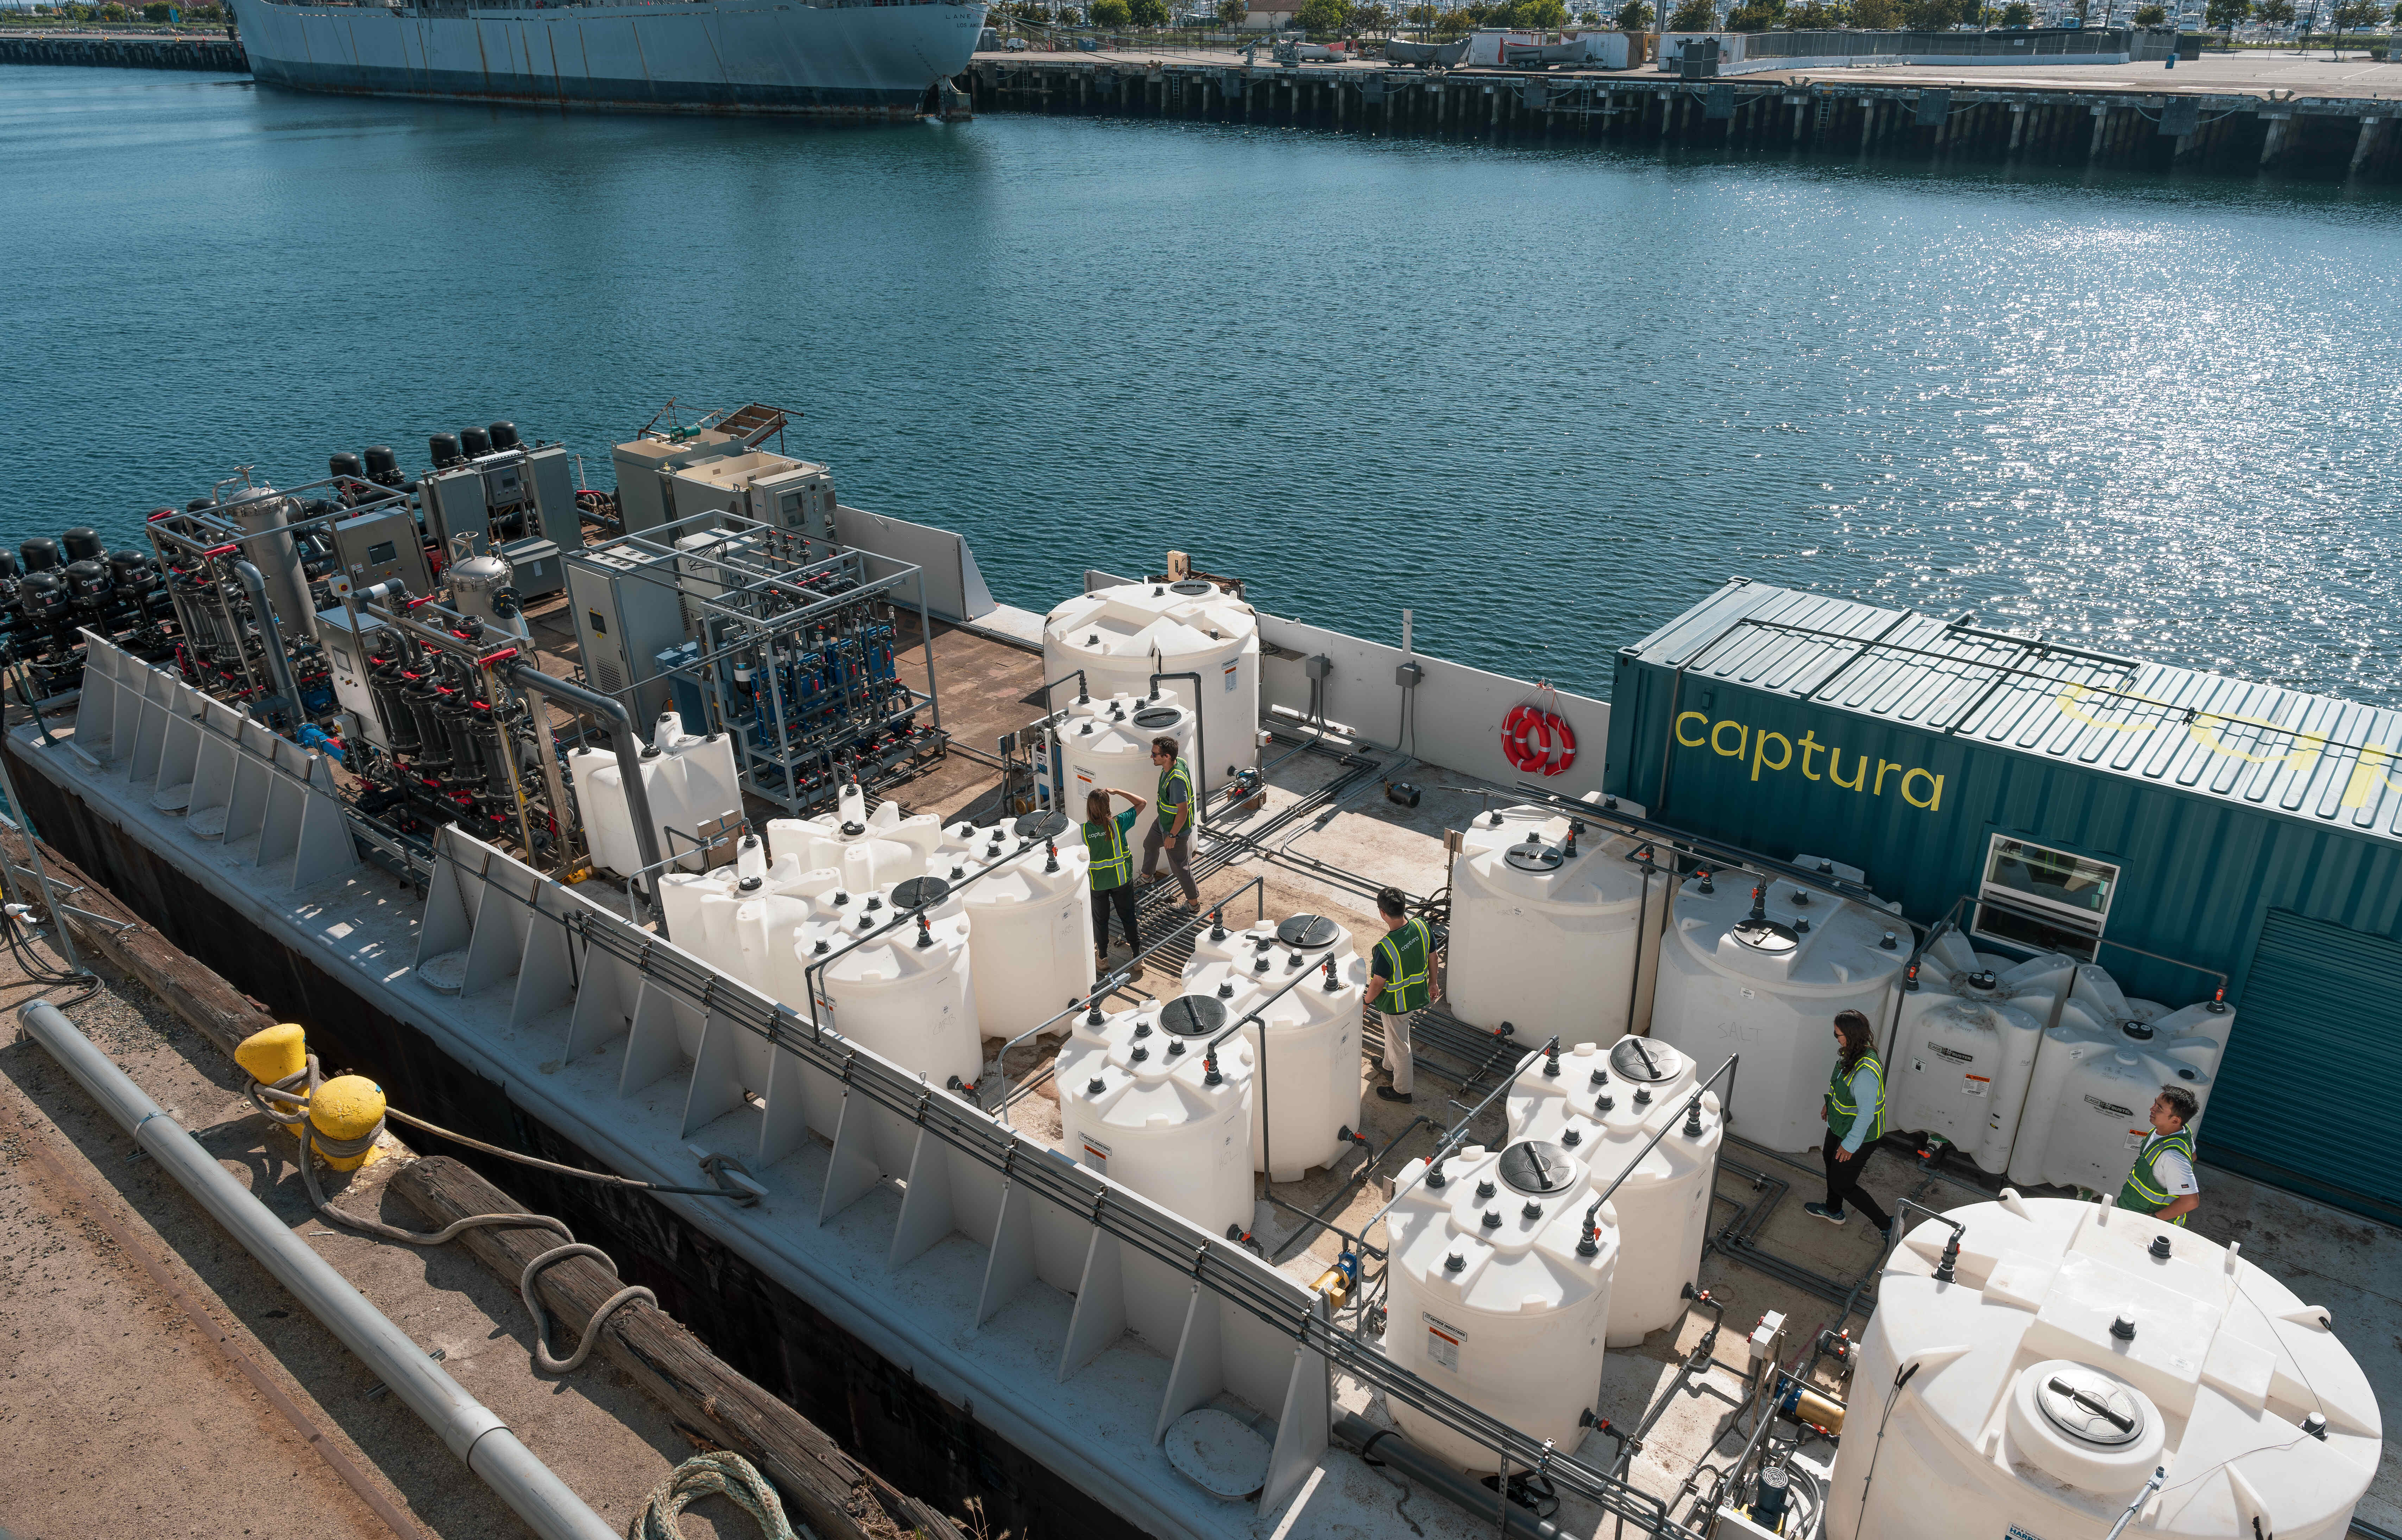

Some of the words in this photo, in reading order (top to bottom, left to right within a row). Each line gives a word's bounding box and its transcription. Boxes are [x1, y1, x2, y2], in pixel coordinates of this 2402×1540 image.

[1675, 711, 1944, 811] captura
[1401, 936, 1419, 951] captura
[933, 1013, 956, 1035] CARB
[1956, 1023, 1972, 1033] Slurry
[1718, 1022, 1763, 1046] SALT
[1929, 1044, 1941, 1052] CAGE
[1952, 1053, 1972, 1061] BUSTER
[2086, 1097, 2100, 1105] CAGE
[2111, 1106, 2129, 1114] BUSTE
[1084, 1135, 1094, 1143] SNYDER
[1094, 1141, 1110, 1151] INDUSTRIES
[1430, 1317, 1444, 1326] SNYDER
[1444, 1324, 1466, 1337] INDUSTRIES
